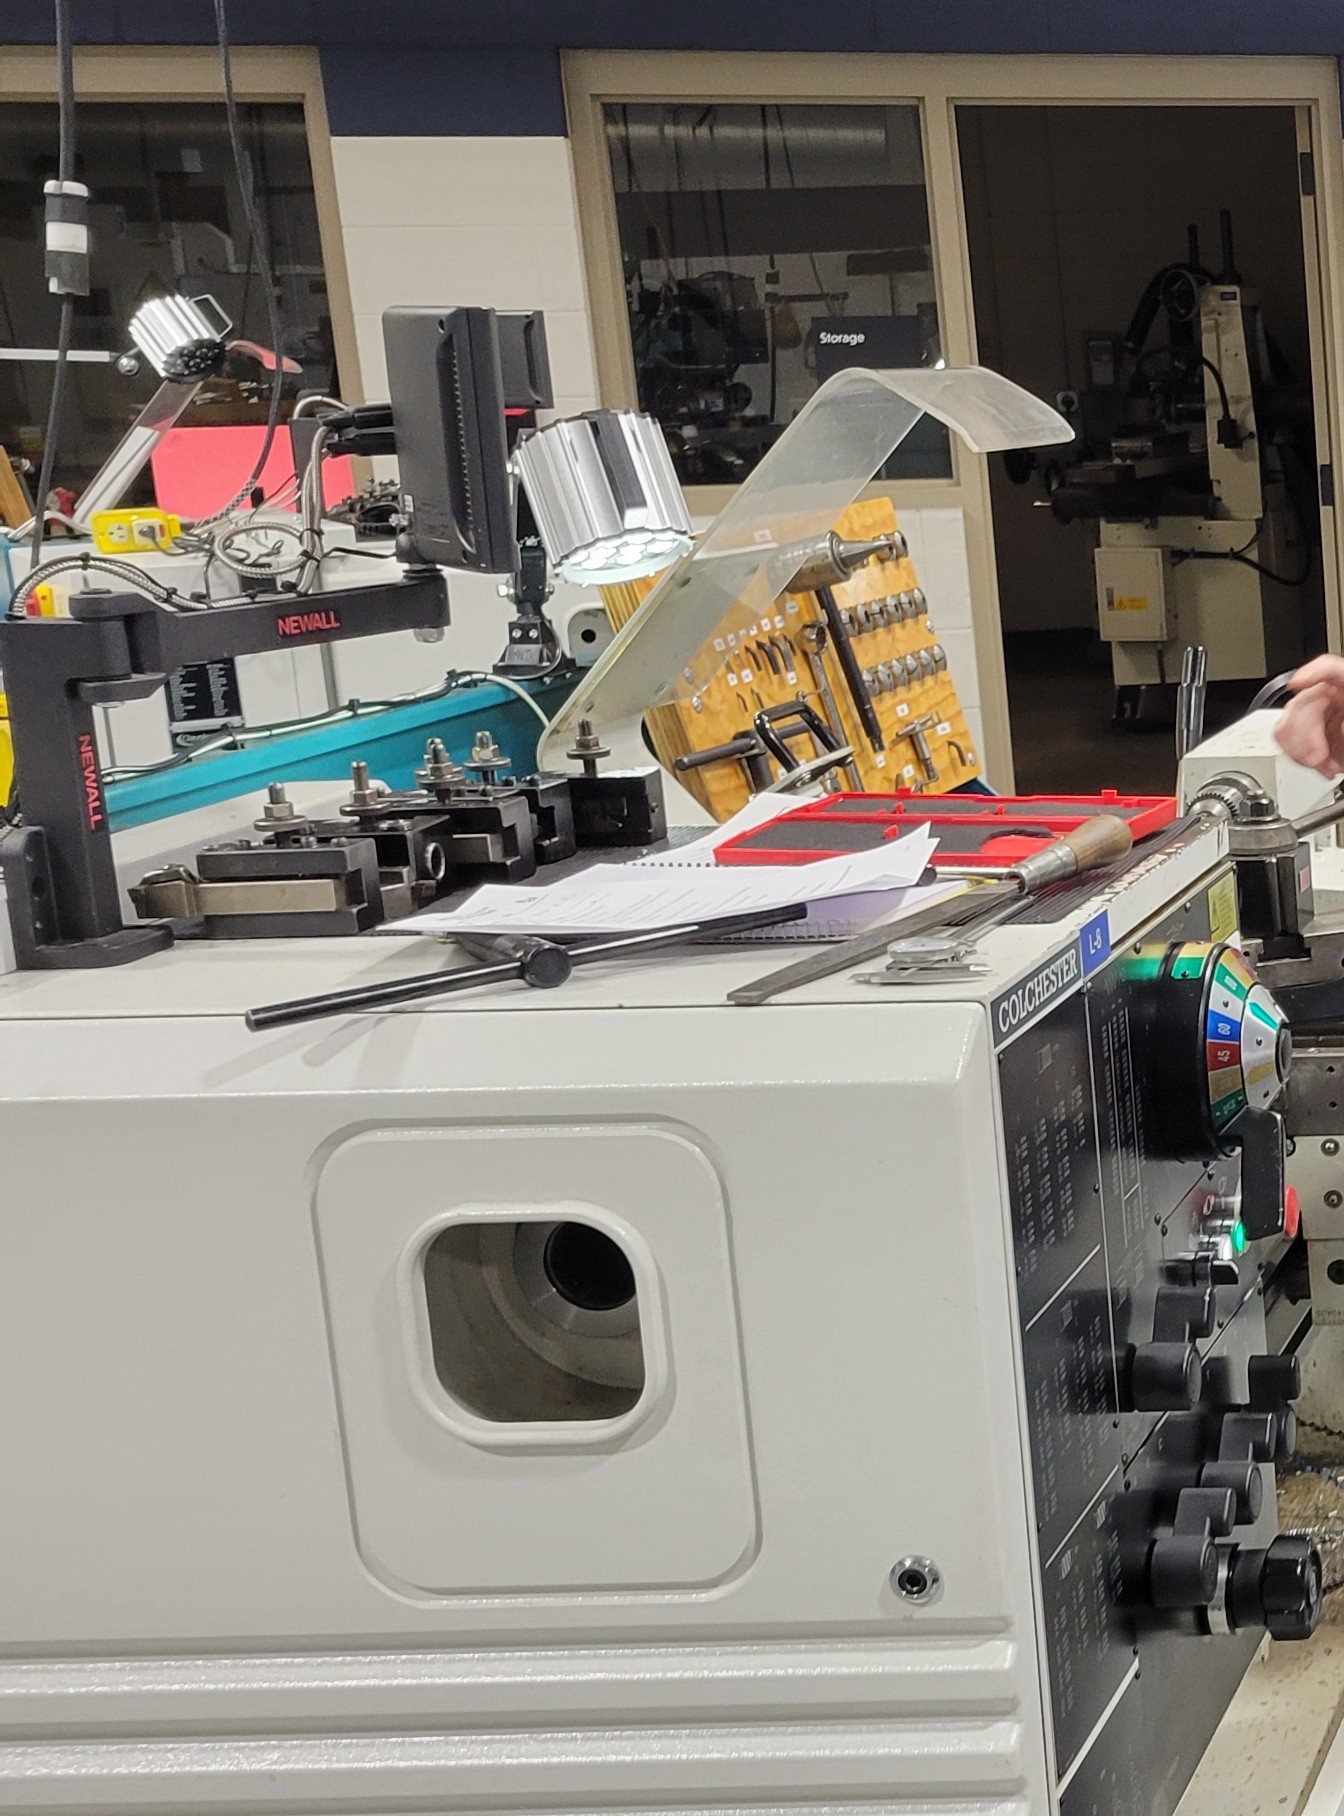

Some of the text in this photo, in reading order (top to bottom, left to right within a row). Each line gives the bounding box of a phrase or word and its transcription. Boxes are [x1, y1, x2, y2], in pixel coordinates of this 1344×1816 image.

[819, 331, 866, 346] Storage
[278, 610, 340, 636] NEWALL
[79, 734, 103, 830] NEWALL
[1088, 927, 1103, 955] L-8
[998, 948, 1078, 1033] COLCHESTER
[1217, 1022, 1231, 1036] 60
[1217, 1049, 1231, 1062] 45
